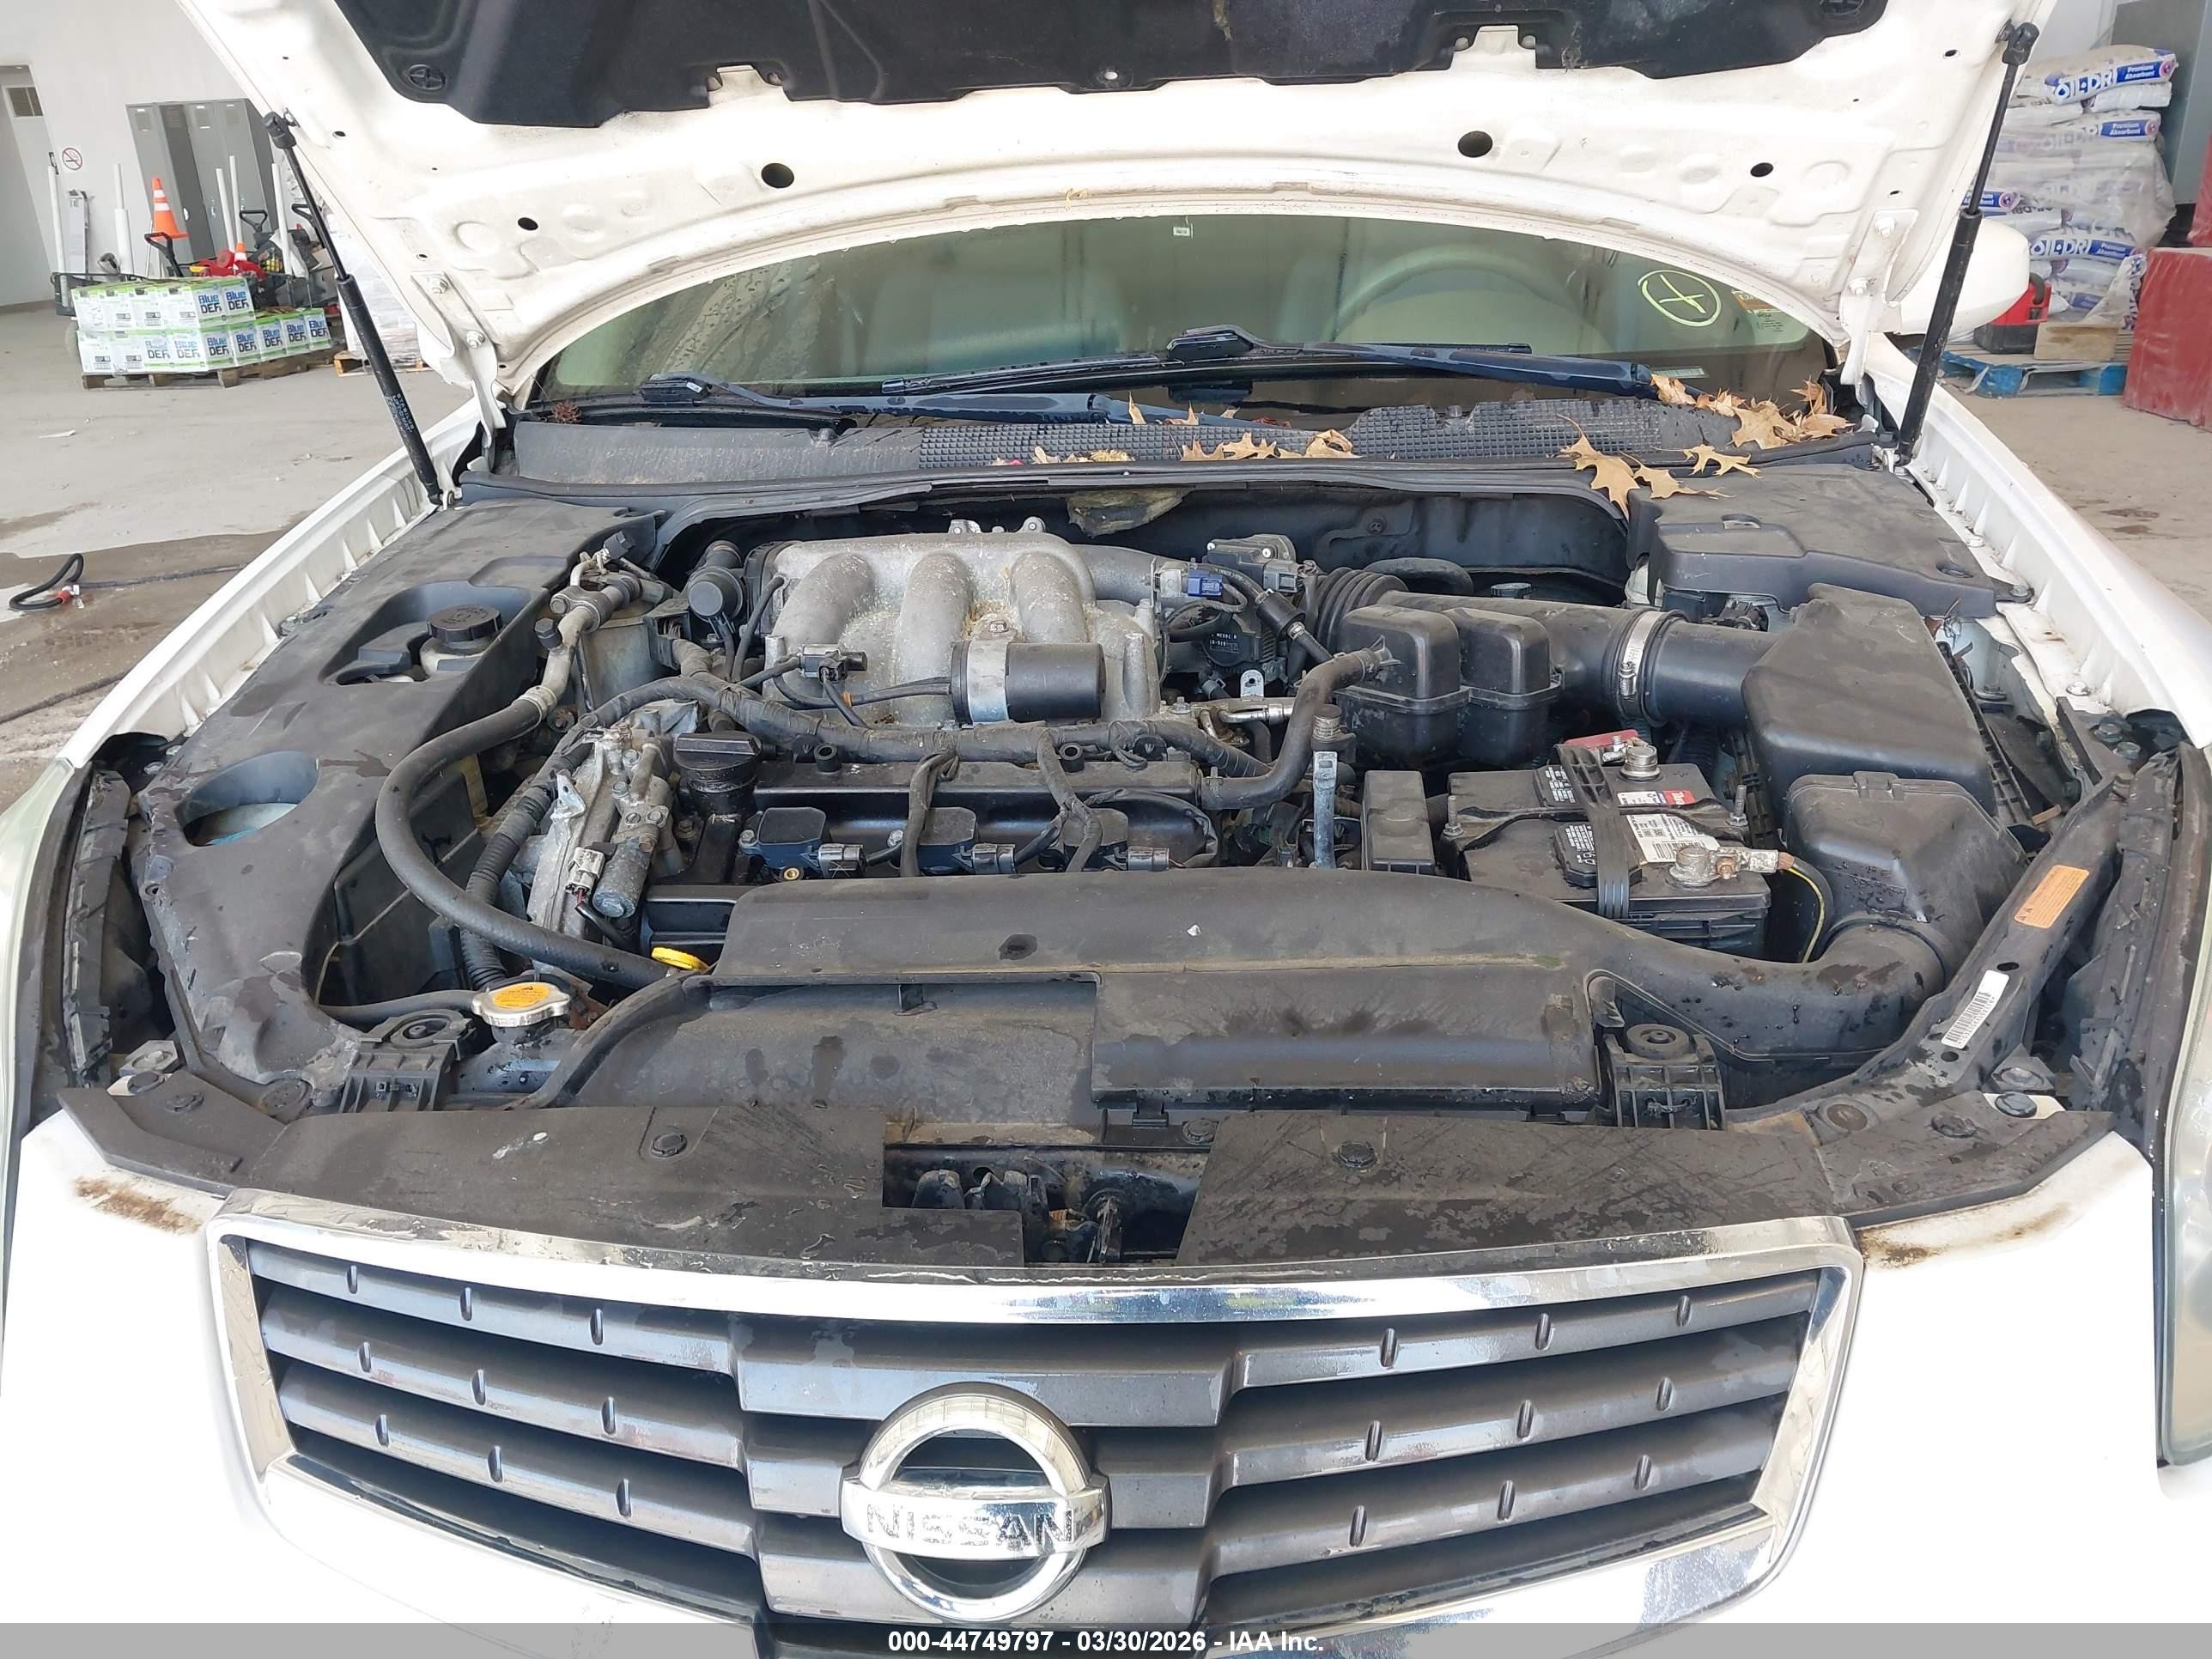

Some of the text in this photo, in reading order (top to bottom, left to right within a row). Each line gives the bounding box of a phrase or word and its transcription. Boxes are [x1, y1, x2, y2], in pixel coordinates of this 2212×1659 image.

[2127, 64, 2154, 74] Premium
[2124, 70, 2155, 80] Absorbent
[198, 295, 219, 304] Blue
[226, 291, 246, 301] Blue
[200, 303, 222, 314] DEF
[228, 299, 249, 311] DEF
[236, 333, 255, 343] Blue
[262, 329, 280, 337] Blue
[207, 337, 228, 346] Blue
[866, 1501, 1073, 1547] NISSAN
